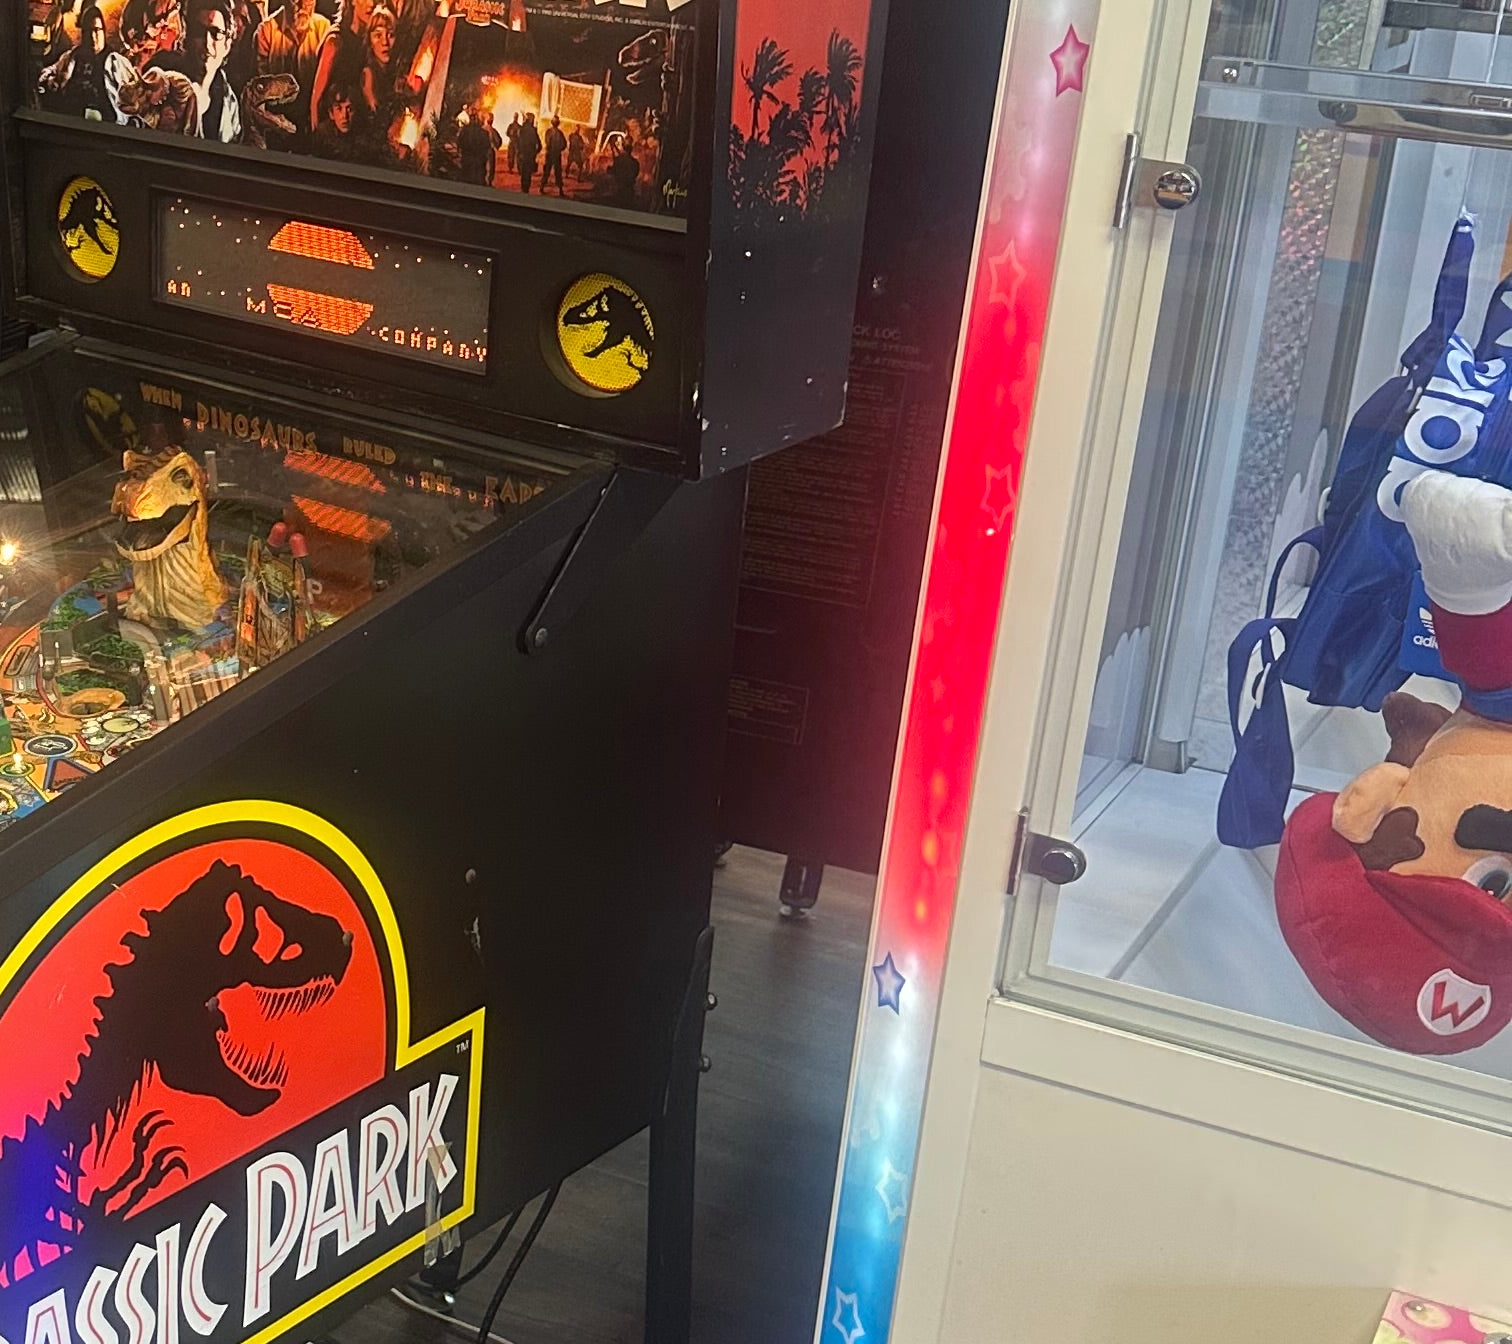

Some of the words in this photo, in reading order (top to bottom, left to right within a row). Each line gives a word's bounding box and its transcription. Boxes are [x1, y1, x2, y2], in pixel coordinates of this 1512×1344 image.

[167, 279, 191, 298] AN
[378, 326, 487, 363] COMPANY
[139, 382, 182, 412] WHEN
[196, 401, 318, 451] DINOSAURS
[343, 436, 396, 465] RULED
[419, 471, 453, 495] THE
[242, 1072, 460, 1329] PARK
